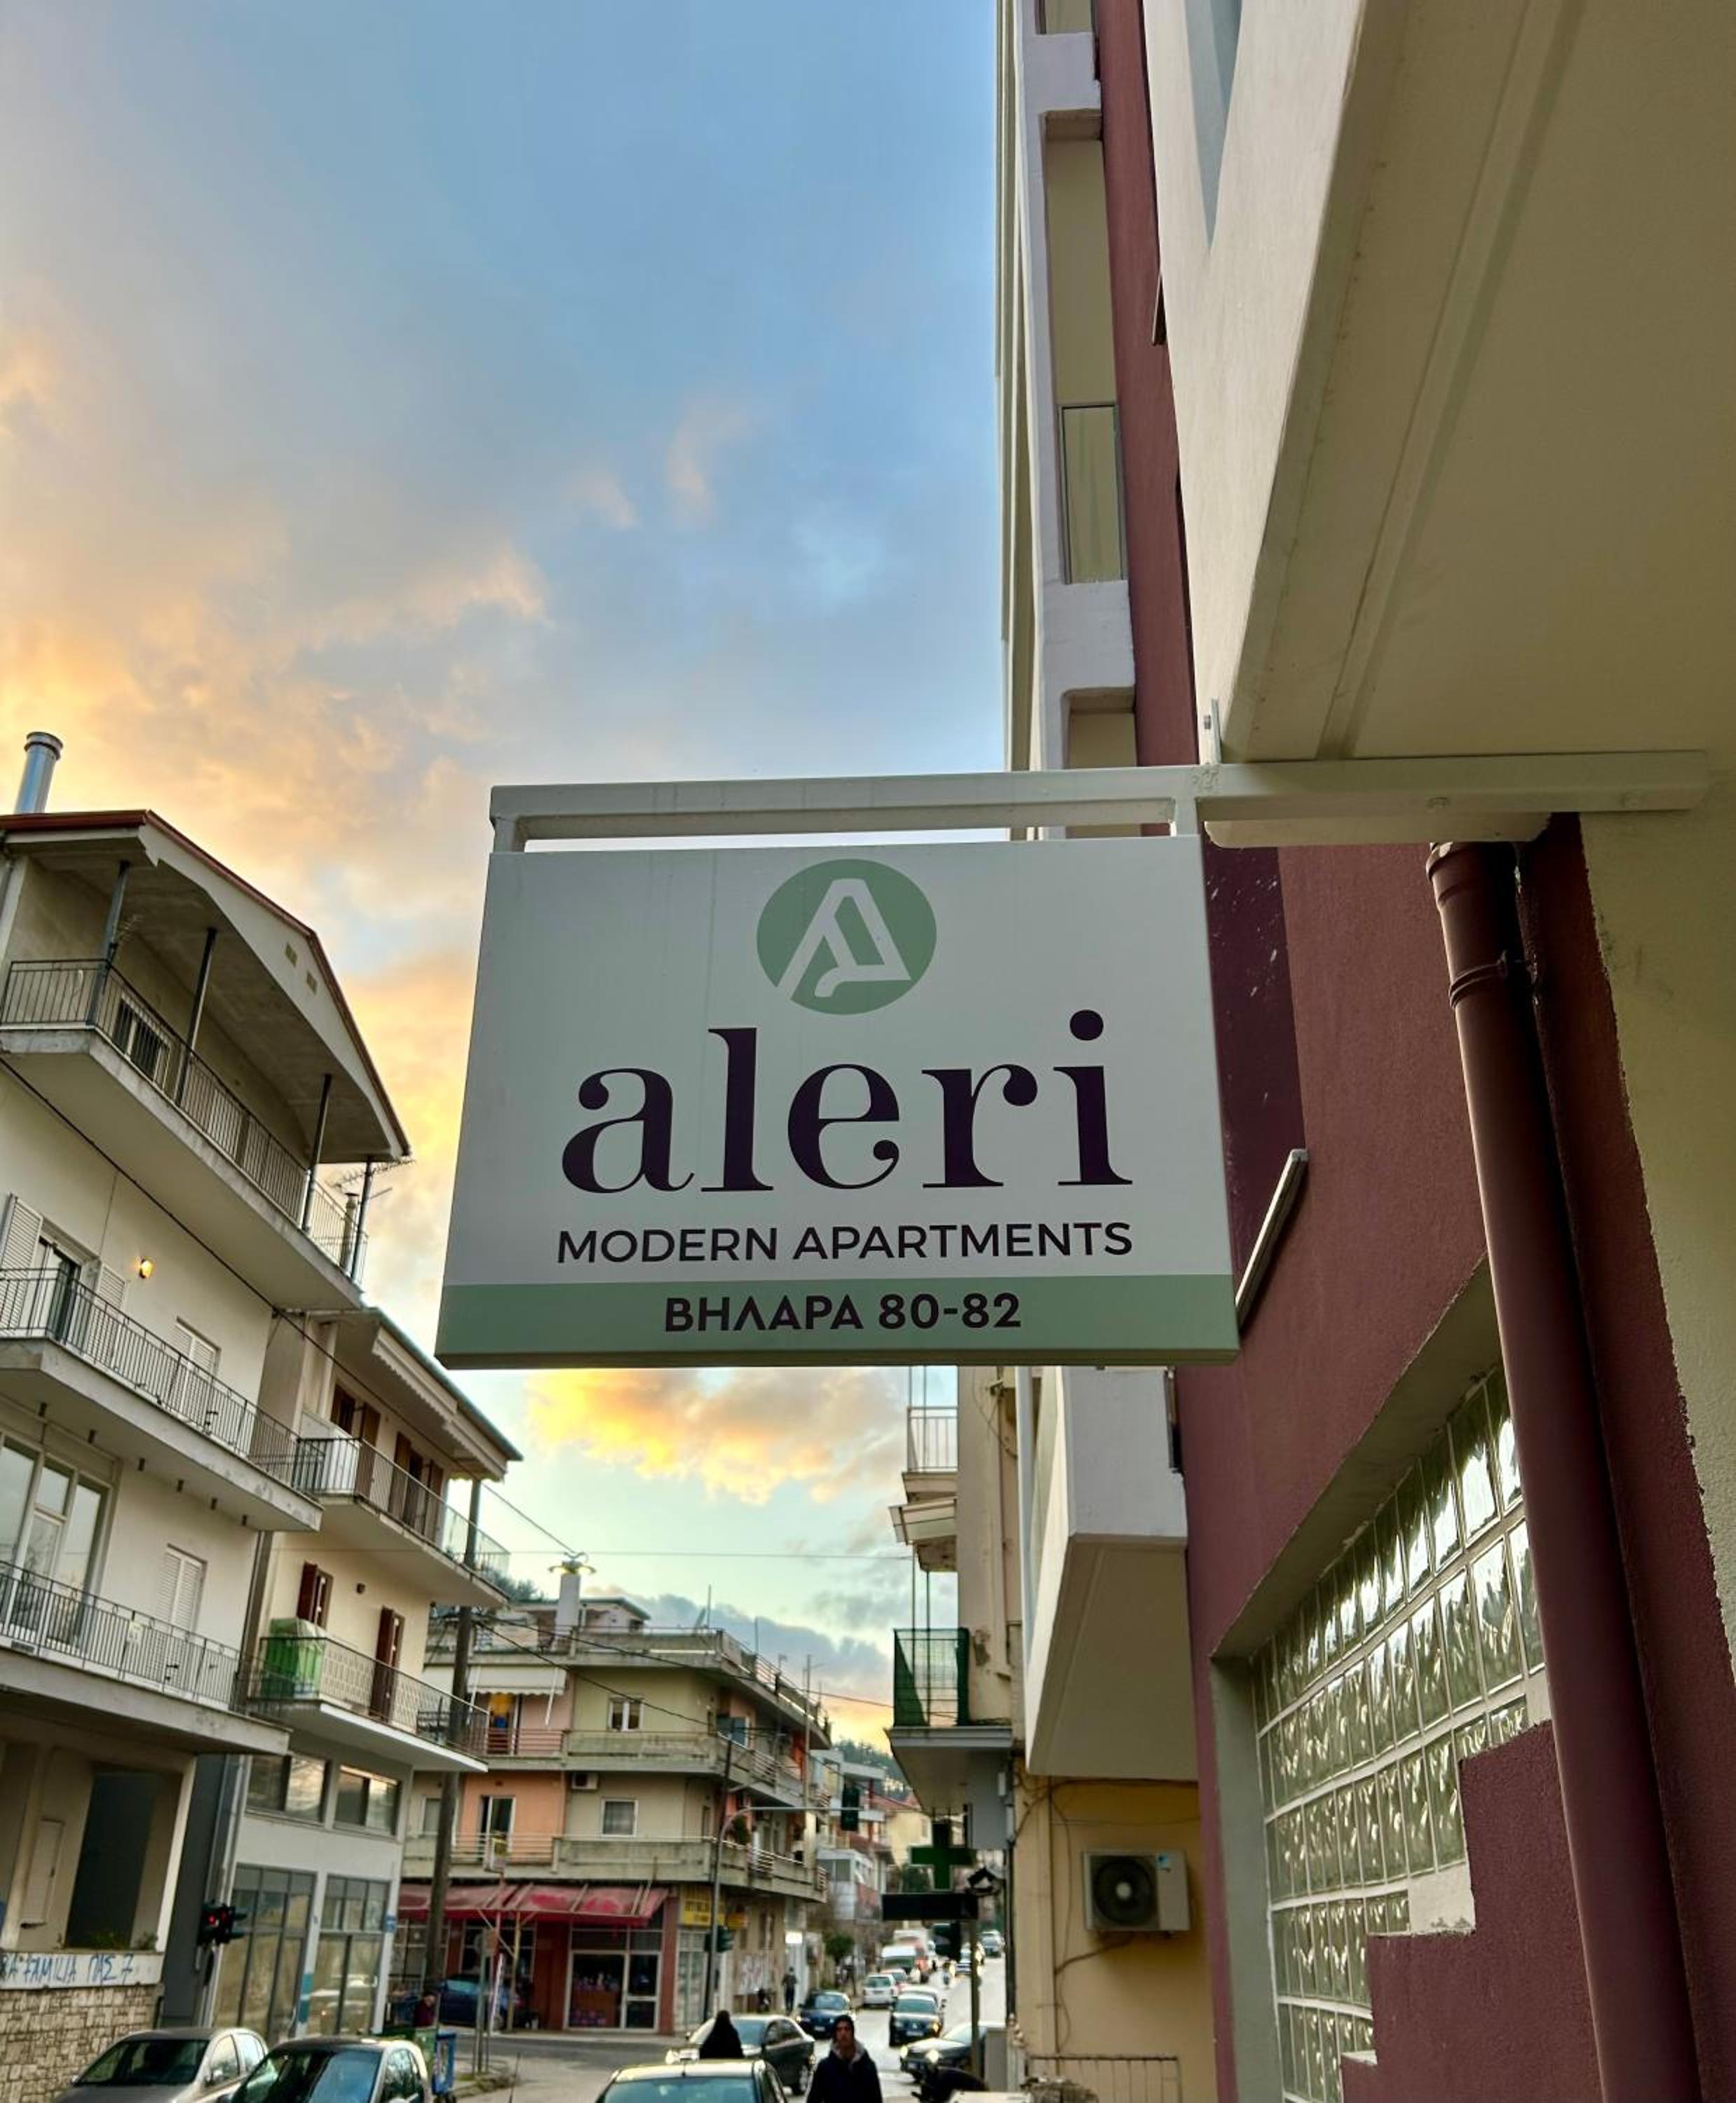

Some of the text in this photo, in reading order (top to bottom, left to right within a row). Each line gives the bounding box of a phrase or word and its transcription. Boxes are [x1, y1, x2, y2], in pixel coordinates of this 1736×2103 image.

[561, 1009, 1134, 1195] aleri
[557, 1222, 1133, 1264] MODERN APARTMENTS
[665, 1292, 1022, 1333] ΒΗΛΑΡΑ 80-82
